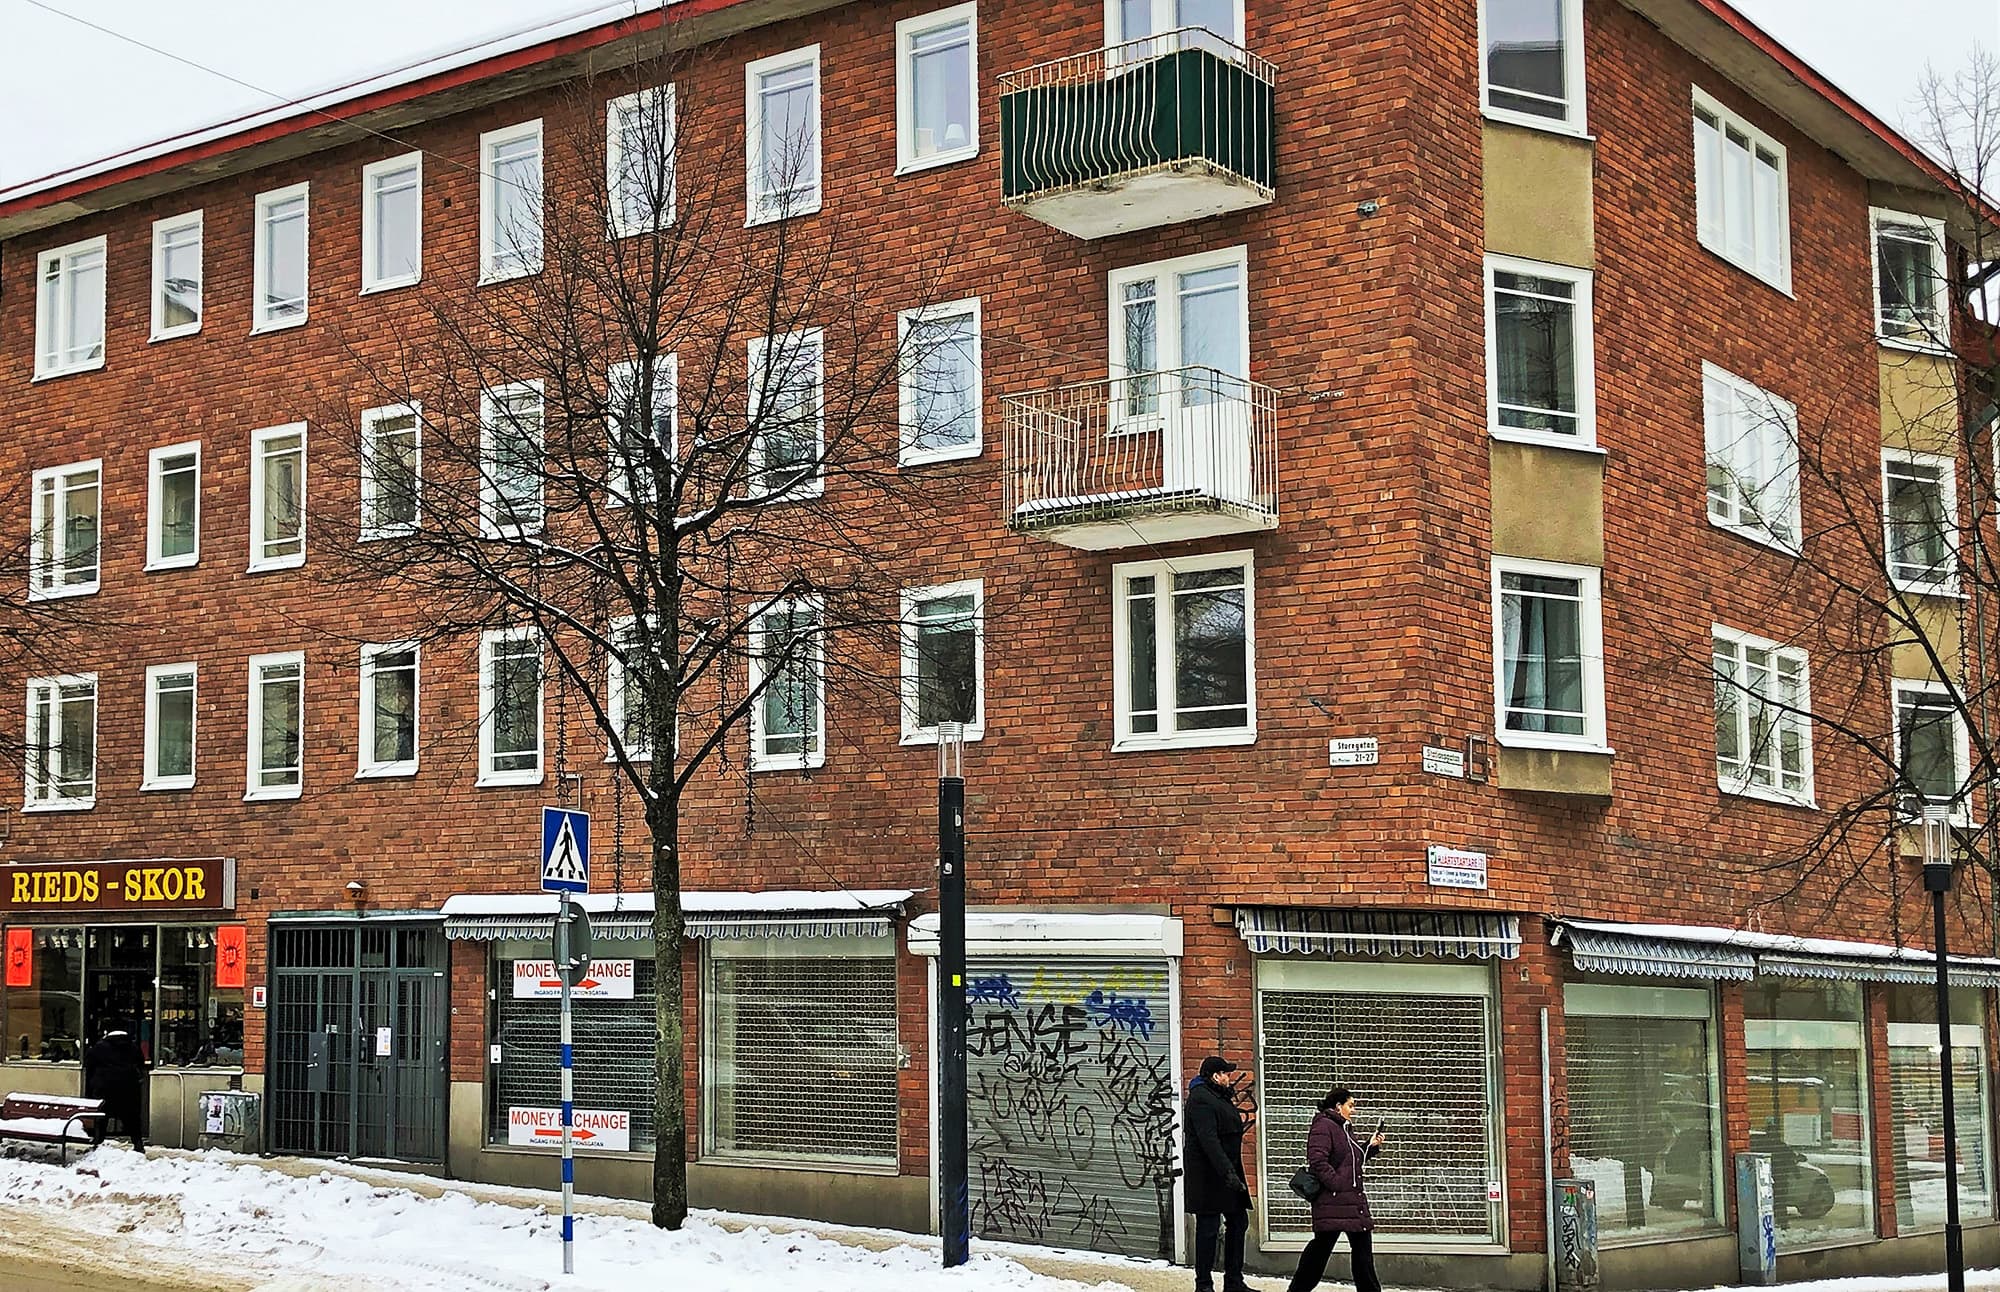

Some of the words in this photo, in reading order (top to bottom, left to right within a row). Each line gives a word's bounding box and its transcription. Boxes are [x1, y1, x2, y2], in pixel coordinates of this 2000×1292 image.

[1355, 753, 1375, 762] 21-27
[11, 870, 100, 903] RIEDS
[124, 867, 206, 902] SKOR
[587, 963, 632, 978] HANGE
[511, 1110, 555, 1126] MONEY
[558, 1112, 628, 1130] ECHANGE
